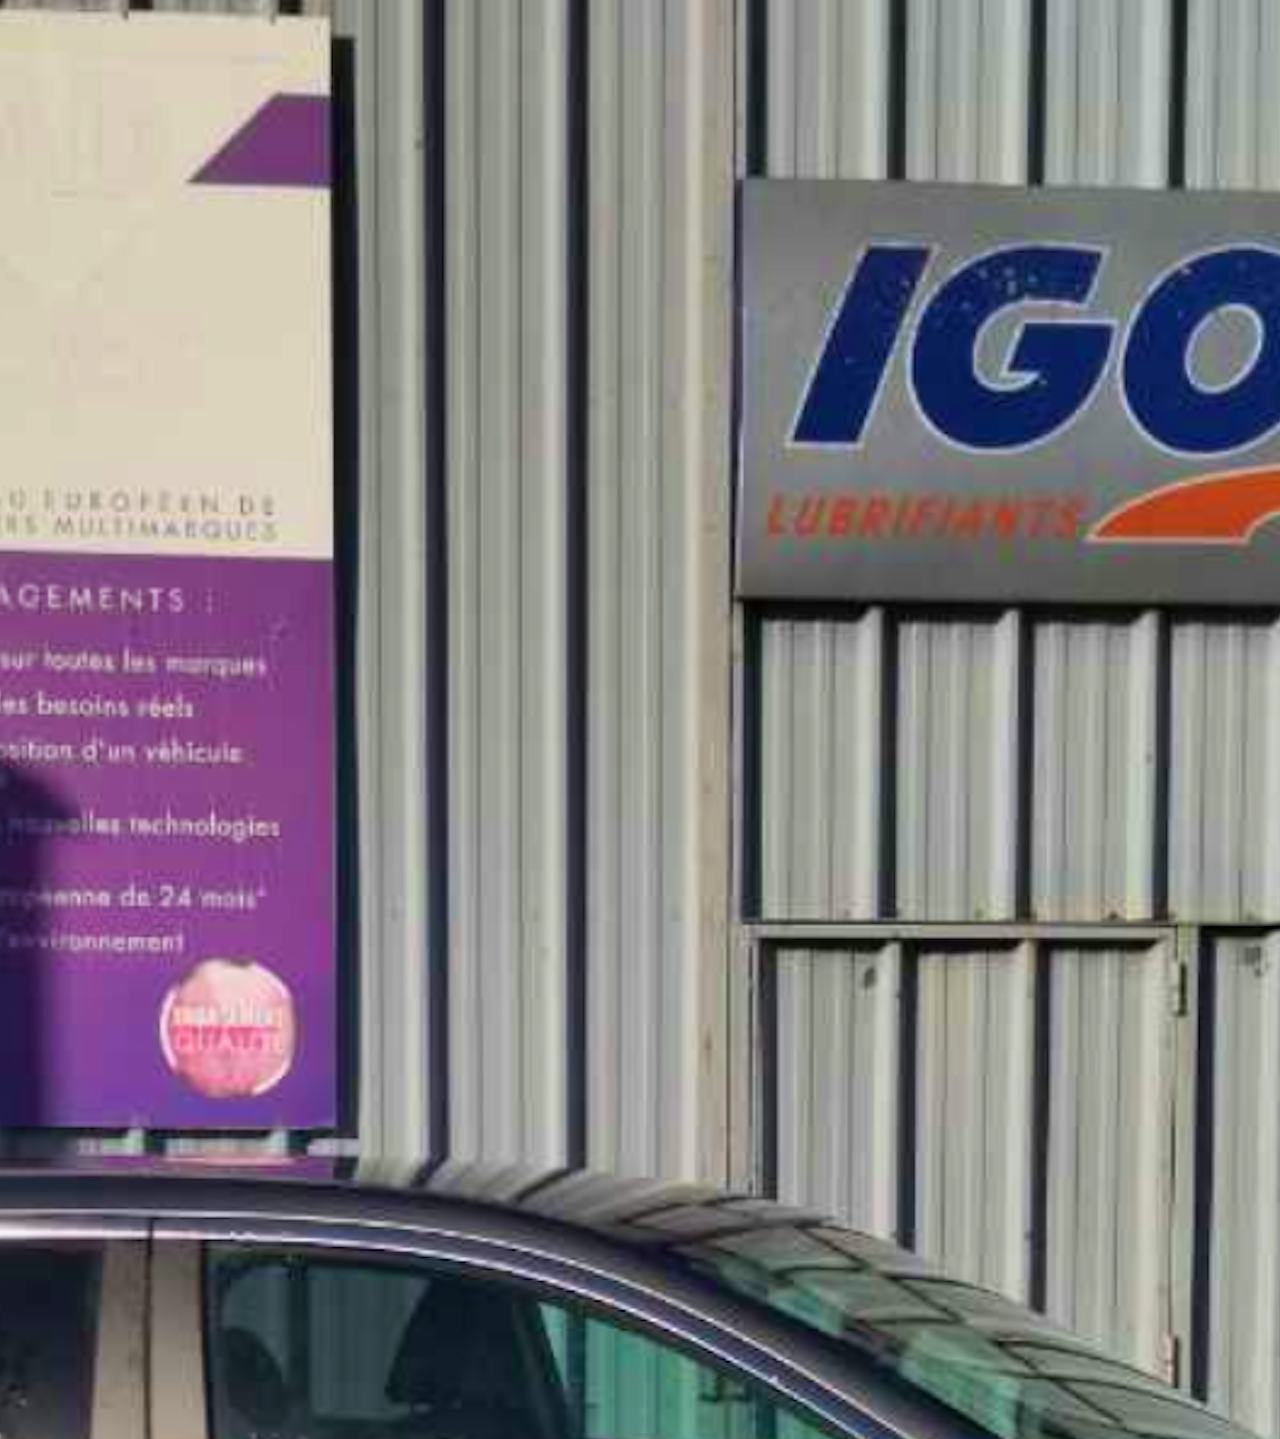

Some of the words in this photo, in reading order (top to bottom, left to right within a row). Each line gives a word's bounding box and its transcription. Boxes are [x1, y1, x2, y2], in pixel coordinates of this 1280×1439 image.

[766, 495, 1086, 539] LUBRIFIANTS
[0, 652, 37, 670] sur
[44, 646, 115, 672] toutes
[123, 649, 156, 673] les
[167, 657, 268, 680] marques
[38, 692, 130, 718] besoins
[81, 737, 136, 762] d'un
[146, 738, 243, 765] véhicule
[130, 809, 281, 843] technologies
[121, 884, 152, 907] de
[159, 885, 192, 908] 24
